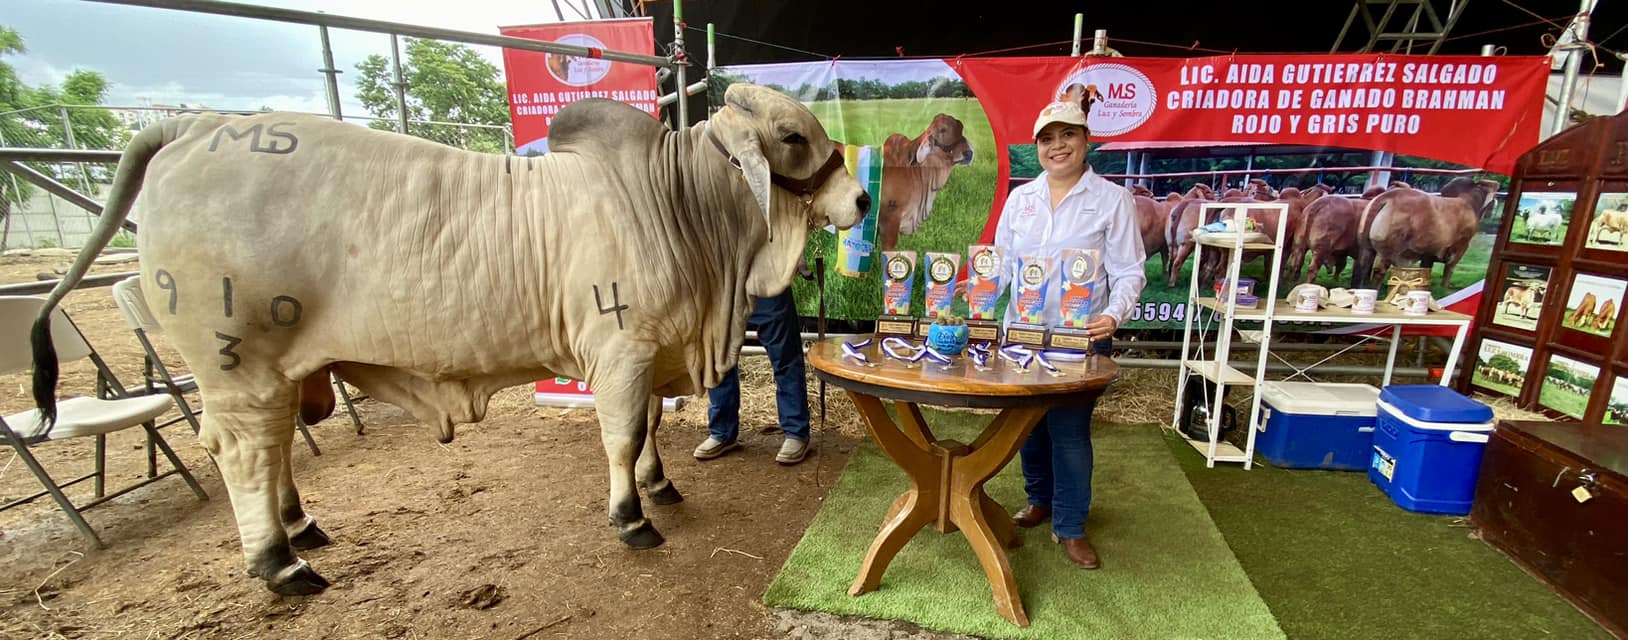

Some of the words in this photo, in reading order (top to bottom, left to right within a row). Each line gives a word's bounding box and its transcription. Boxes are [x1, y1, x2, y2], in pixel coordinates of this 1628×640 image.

[1180, 65, 1219, 85] LIC.
[1226, 63, 1274, 84] AIDA
[1282, 62, 1397, 84] GUTIERREZ
[1402, 63, 1497, 84] SALGADO
[513, 93, 530, 104] LIC.
[533, 92, 555, 103] AIDA
[612, 90, 656, 101] SALGADO
[1108, 83, 1136, 100] MS
[1166, 89, 1270, 110] CRIADORA
[1277, 89, 1303, 109] DE
[1310, 88, 1396, 109] GANADO
[1401, 89, 1505, 110] BRAHMAN
[517, 103, 559, 115] CRIADORA
[1231, 114, 1281, 134] ROJO
[1289, 114, 1301, 134] Y
[1307, 114, 1359, 134] GRIS
[1365, 114, 1420, 134] PURO
[208, 122, 298, 154] MS
[155, 269, 177, 315] 9
[223, 277, 233, 318] 1
[270, 295, 302, 327] 0
[592, 282, 629, 330] 4
[215, 331, 242, 371] 3
